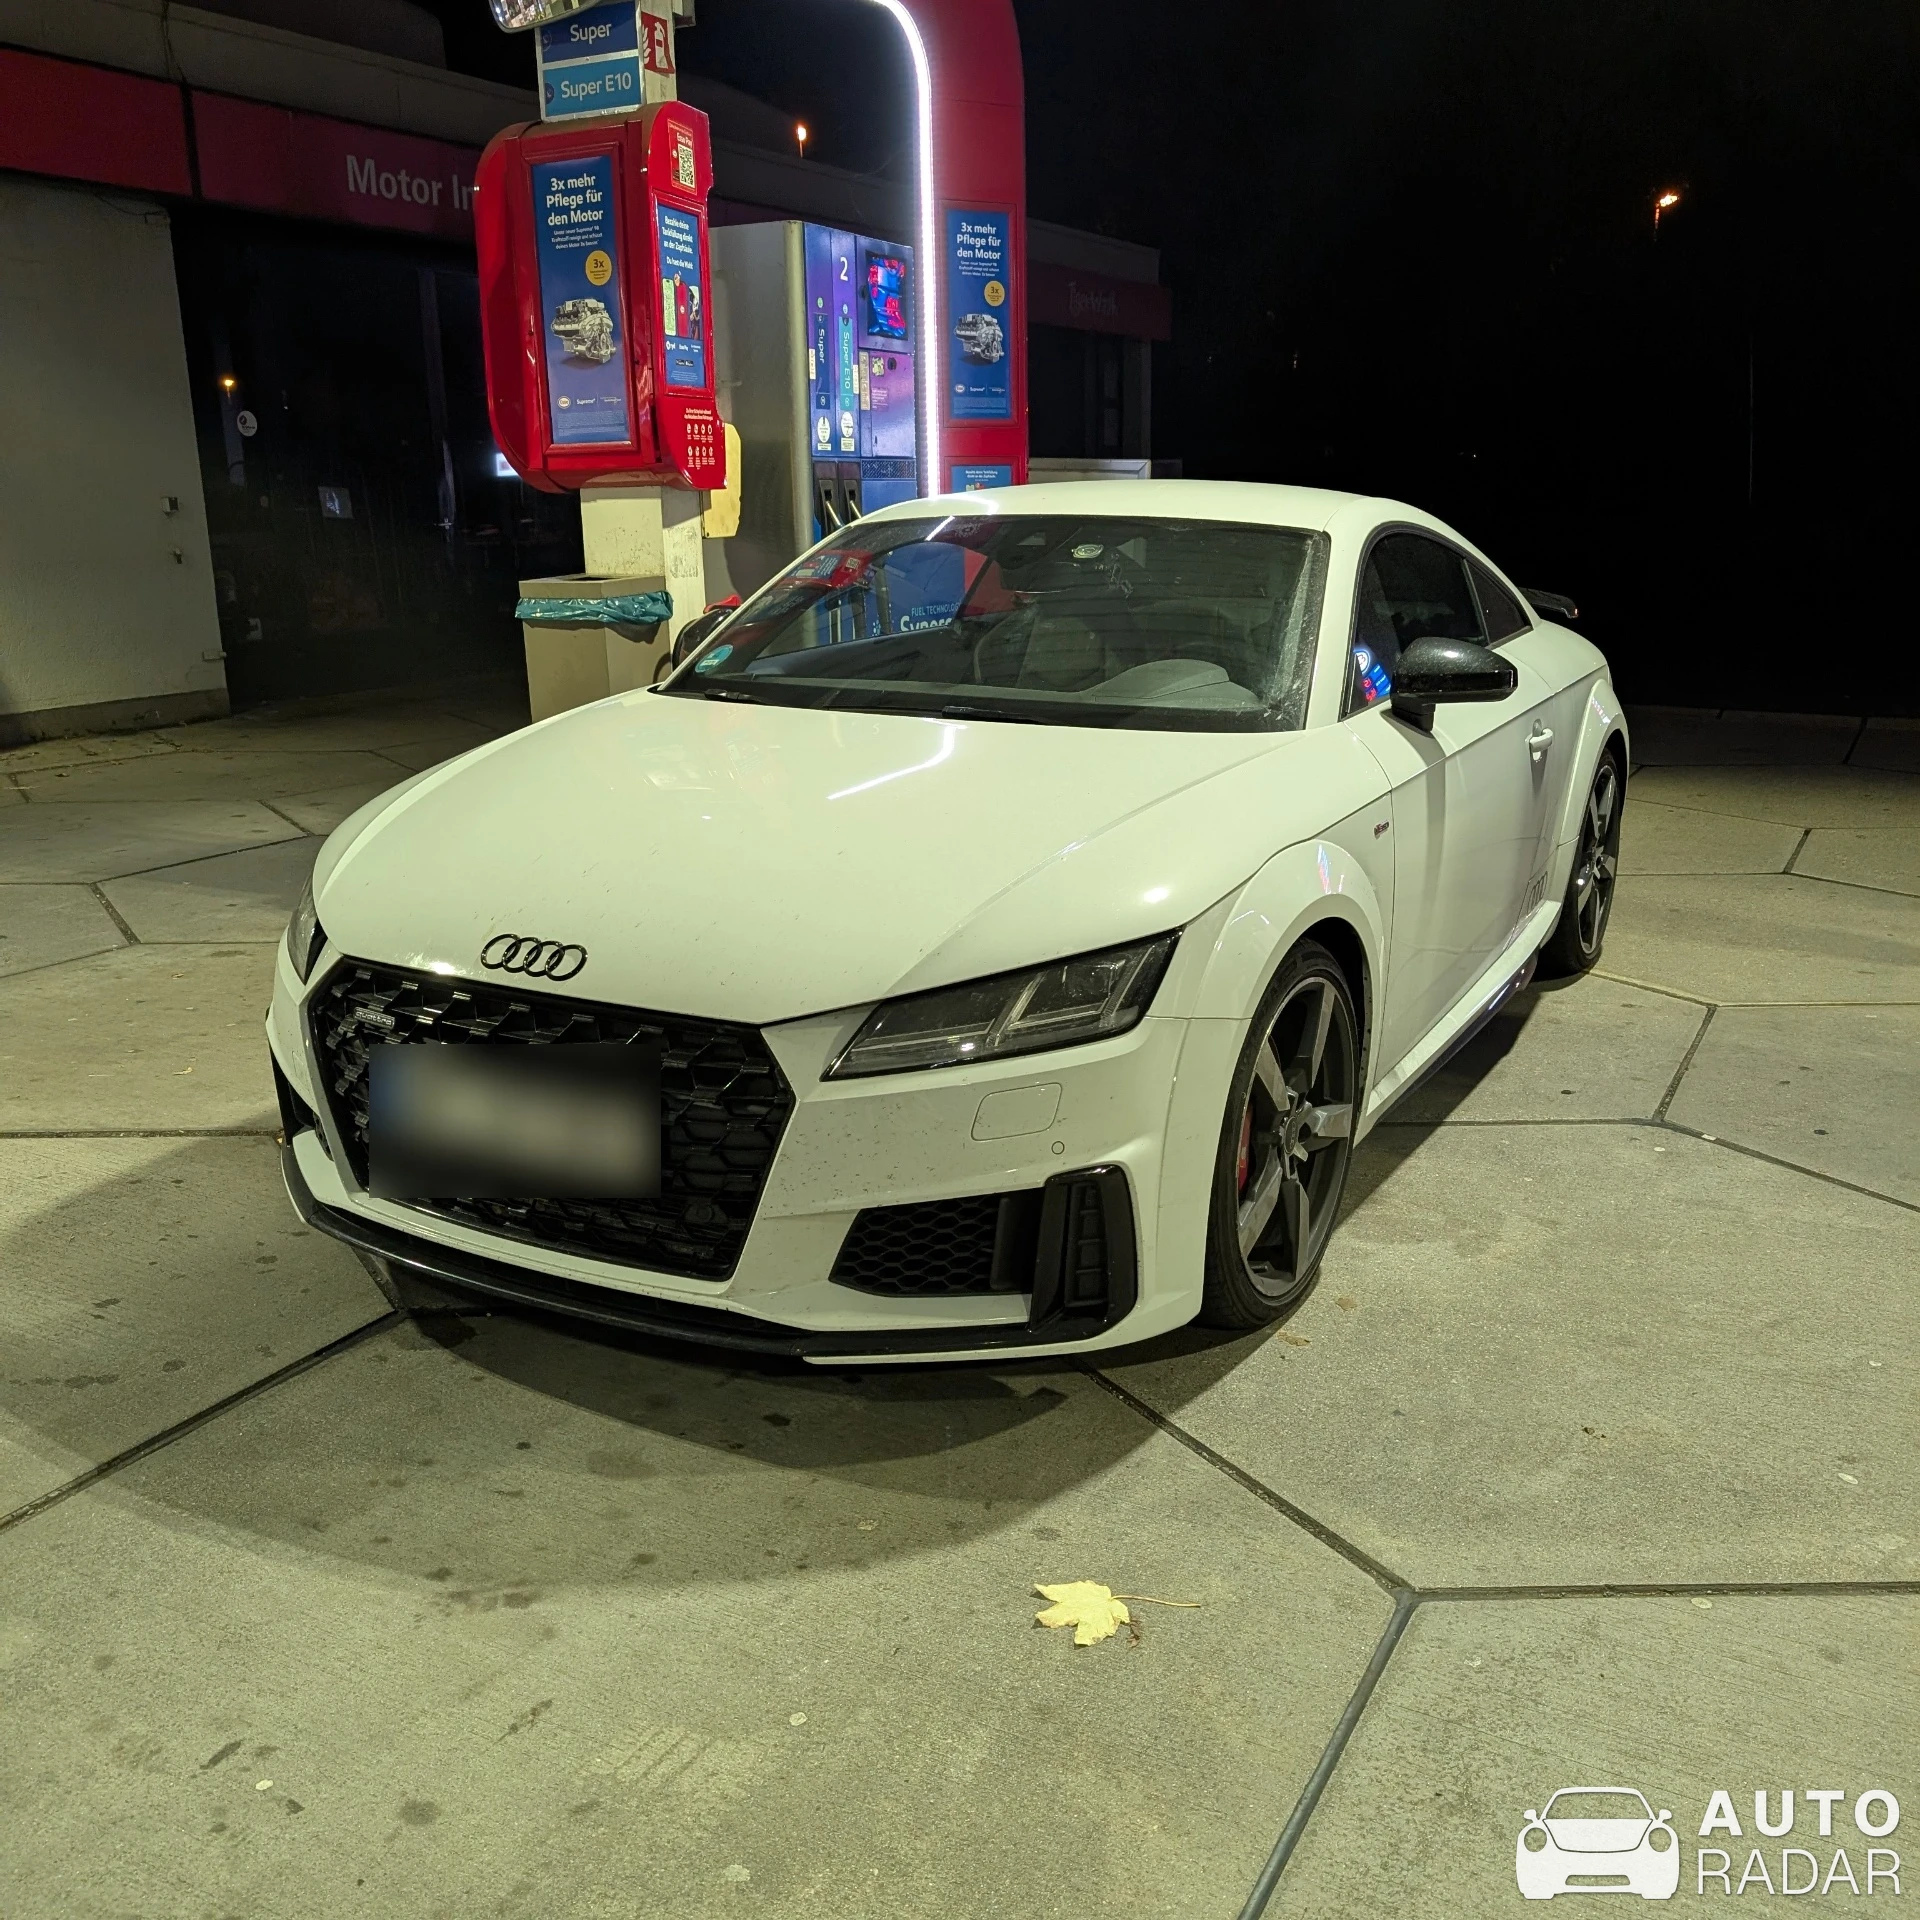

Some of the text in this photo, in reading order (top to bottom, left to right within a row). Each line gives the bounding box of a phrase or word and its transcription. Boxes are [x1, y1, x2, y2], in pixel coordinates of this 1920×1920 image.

[569, 23, 612, 45] Super
[561, 72, 632, 101] Super E10
[346, 154, 442, 206] Motor
[550, 173, 596, 191] 3x mehr
[546, 189, 603, 209] Pflege für
[547, 209, 603, 226] den Motor
[961, 222, 997, 235] 3x mehr
[956, 234, 1001, 248] Pflege für
[957, 247, 1001, 260] den Motor
[593, 259, 605, 269] 3x
[840, 256, 848, 281] 2
[990, 286, 1000, 295] 3x
[843, 331, 851, 365] Super
[911, 602, 961, 617] FUEL TECHNOLOG
